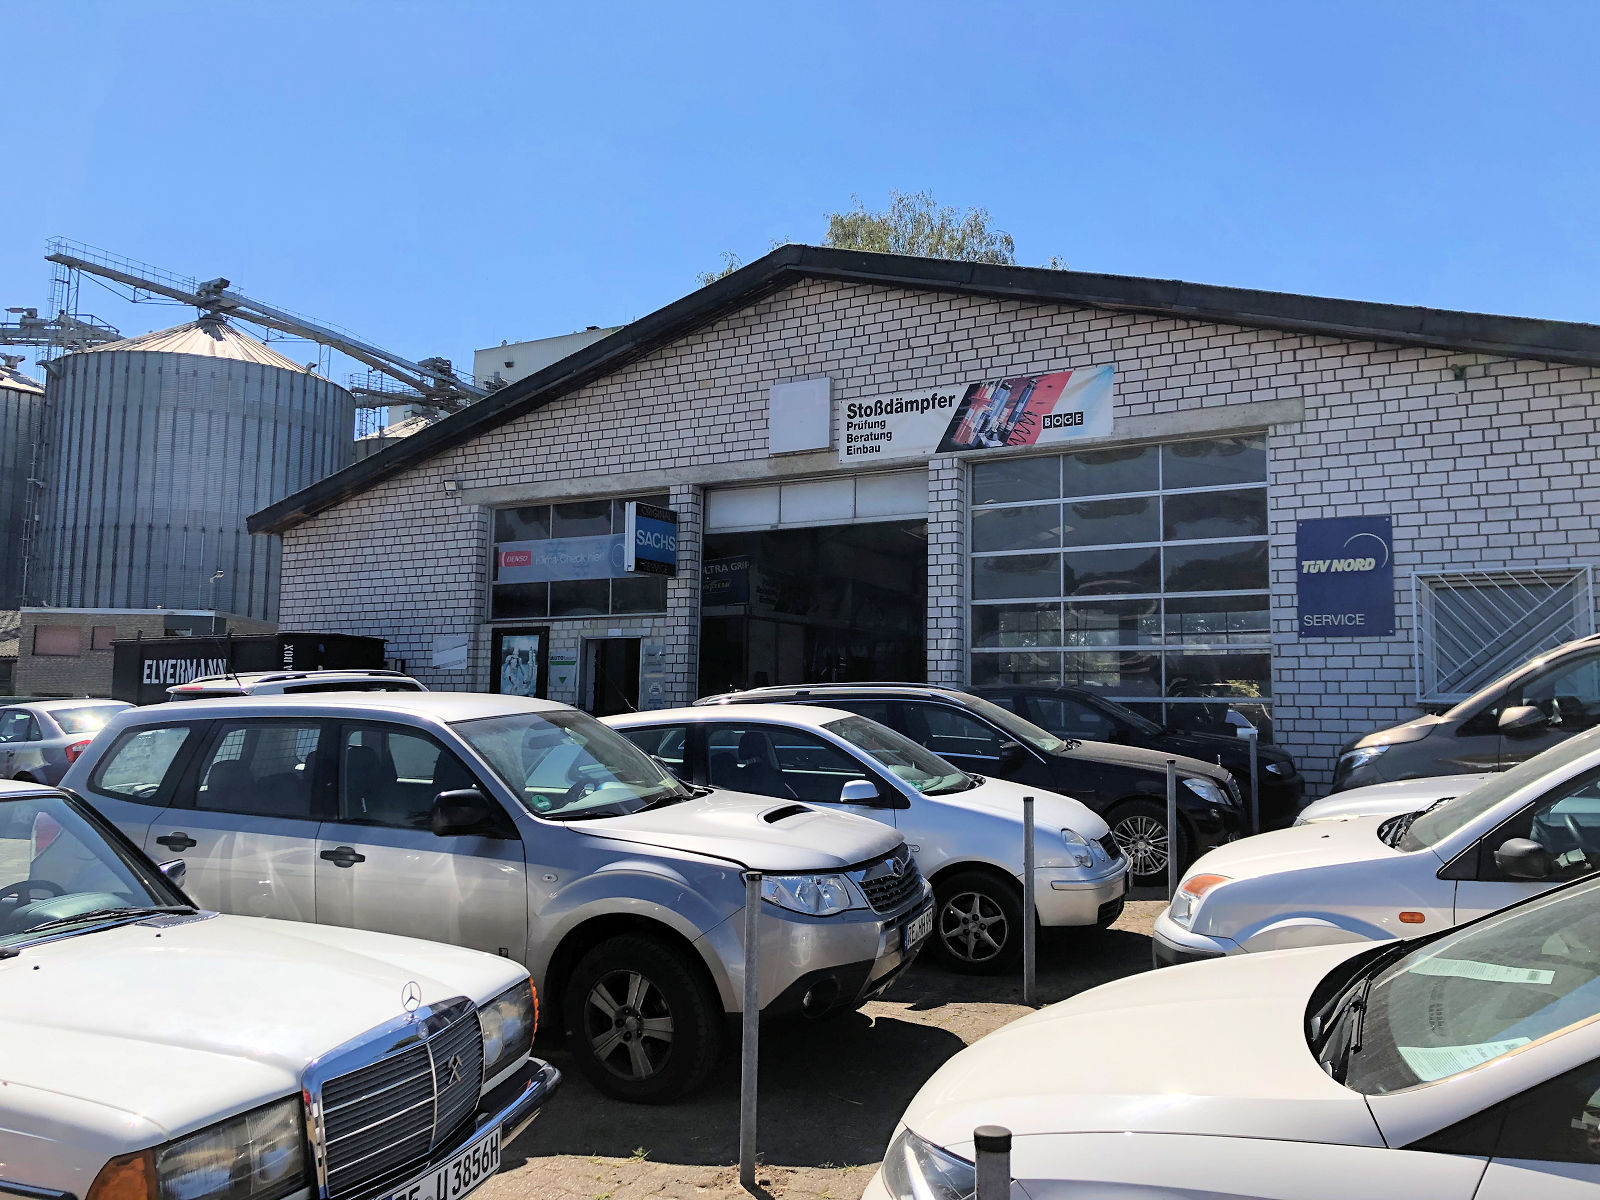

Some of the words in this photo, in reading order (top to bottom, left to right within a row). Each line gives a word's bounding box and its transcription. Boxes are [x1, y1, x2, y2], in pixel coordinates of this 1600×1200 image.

[846, 393, 956, 419] Stoßdämpfer
[846, 419, 886, 431] Prüfung
[1043, 412, 1083, 428] BOGE
[846, 431, 893, 443] Beratung
[846, 444, 881, 455] Einbau
[636, 529, 676, 552] SACHS
[506, 555, 529, 563] DENSO
[1302, 560, 1331, 573] TÜV
[1331, 558, 1376, 572] NORD
[1303, 613, 1365, 626] SERVICE
[283, 643, 293, 662] BOX
[142, 658, 228, 685] ELVERMANN
[451, 1131, 499, 1196] 3856H
